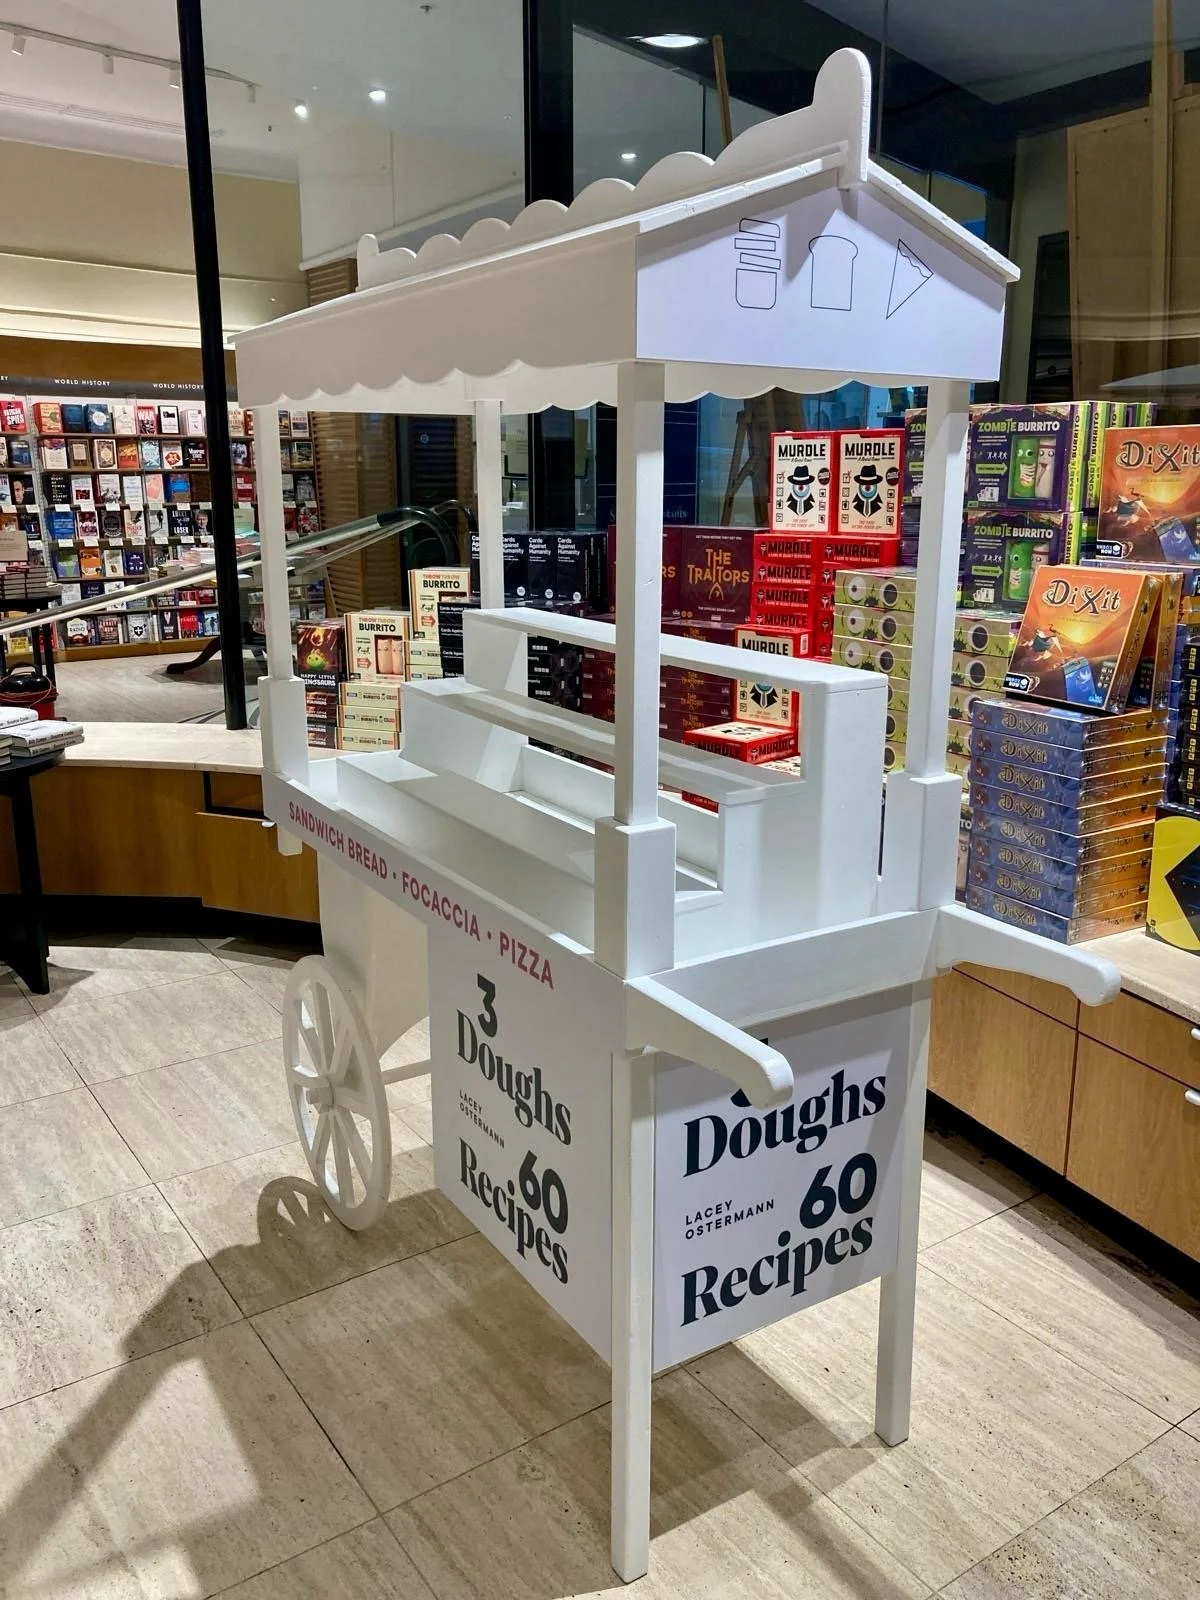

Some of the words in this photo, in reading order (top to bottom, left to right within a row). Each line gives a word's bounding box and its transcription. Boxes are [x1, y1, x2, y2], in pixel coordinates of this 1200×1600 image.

[6, 414, 24, 426] SPIES
[138, 409, 154, 420] WAR
[978, 418, 1016, 433] ZOMBIE
[1018, 420, 1060, 432] BURRITO
[1072, 415, 1080, 460] BURRITO
[1091, 412, 1100, 459] BURRITO
[778, 443, 826, 458] MURDLE
[845, 442, 895, 457] MURDLE
[174, 526, 188, 534] LOSER
[974, 523, 1012, 538] ZOMBIE
[1012, 526, 1054, 538] BURRITO
[706, 548, 732, 567] THE
[768, 542, 812, 554] MURDLE
[834, 544, 880, 558] MURDLE
[688, 564, 750, 588] TRAITORS
[766, 566, 811, 578] MURDLE
[423, 579, 460, 589] BURRITO
[766, 590, 809, 602] MURDLE
[358, 623, 396, 632] BURRITO
[765, 614, 808, 628] MURDLE
[741, 638, 789, 656] MURDLE
[288, 801, 344, 853] SANDWICH
[348, 838, 388, 880] BREAD
[402, 872, 480, 941] FOCACCIA
[500, 931, 554, 990] PIZZA
[476, 972, 498, 1038] 3
[456, 1008, 572, 1146] Doughs
[459, 1089, 482, 1115] LACEY
[459, 1102, 505, 1149] OSTERMANN
[683, 1069, 886, 1178] Doughs
[518, 1150, 568, 1234] 60
[800, 1152, 877, 1230] 60
[459, 1136, 569, 1285] Recipes
[685, 1200, 775, 1240] OSTERMANN
[686, 1200, 733, 1226] LACEY
[680, 1216, 873, 1328] Recipes
